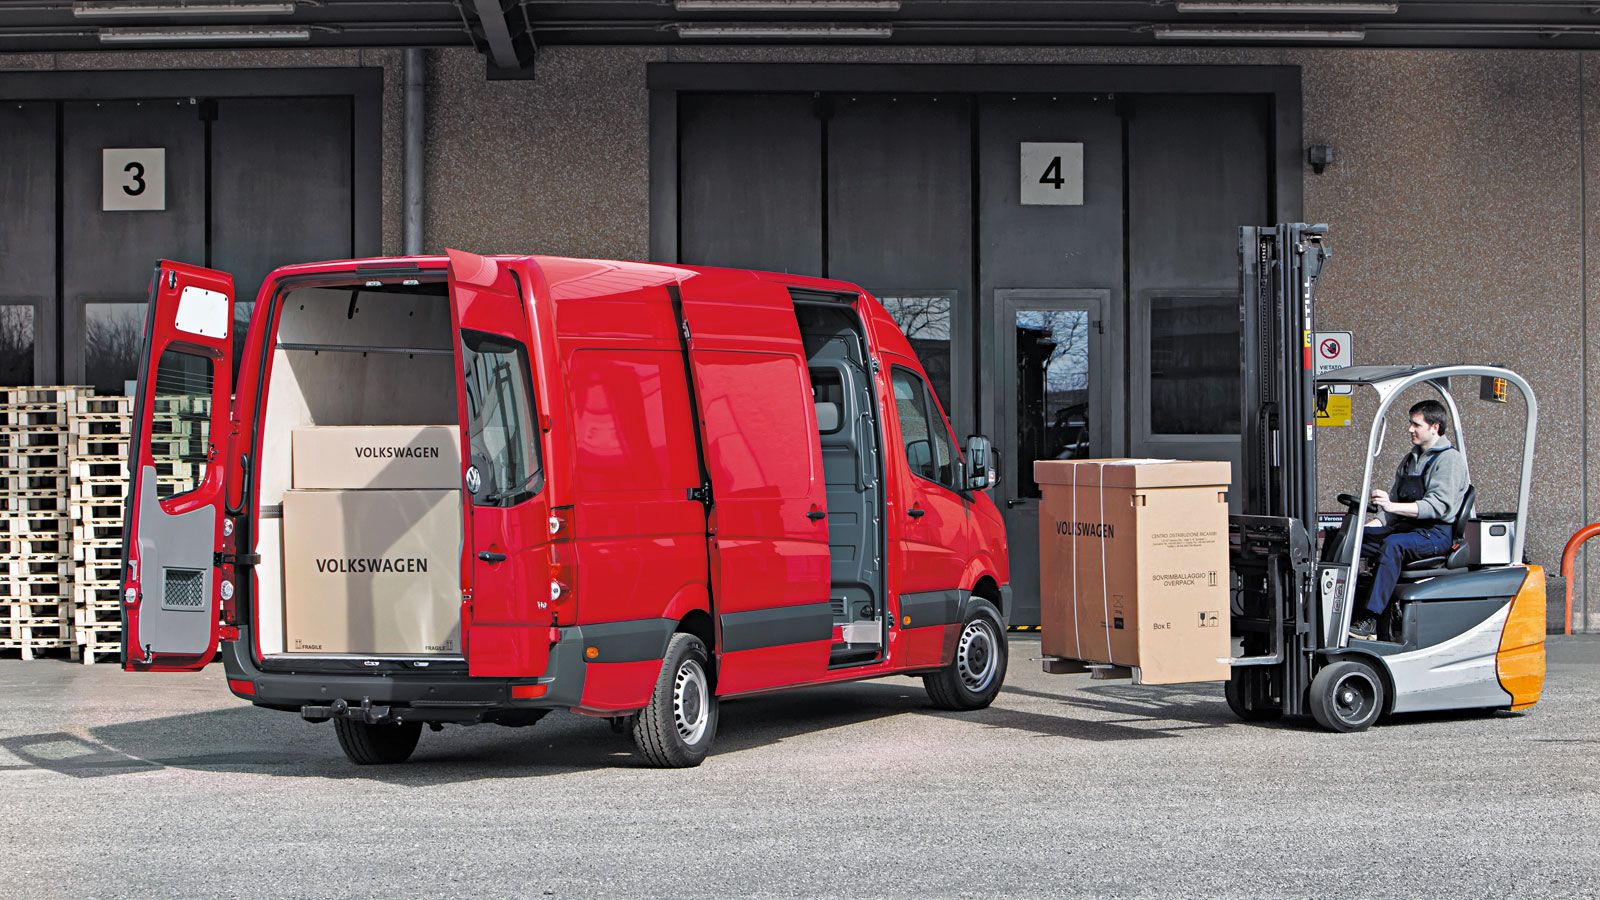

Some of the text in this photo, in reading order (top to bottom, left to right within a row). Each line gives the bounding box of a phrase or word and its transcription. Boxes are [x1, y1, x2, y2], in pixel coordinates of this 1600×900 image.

[122, 161, 146, 197] 3
[1038, 155, 1066, 190] 4
[355, 446, 439, 458] VOLKSWAGEN
[316, 558, 428, 573] VOLKSWAGEN
[1152, 572, 1207, 581] SOVRIMBALLAGGIO
[1153, 622, 1166, 630] Box
